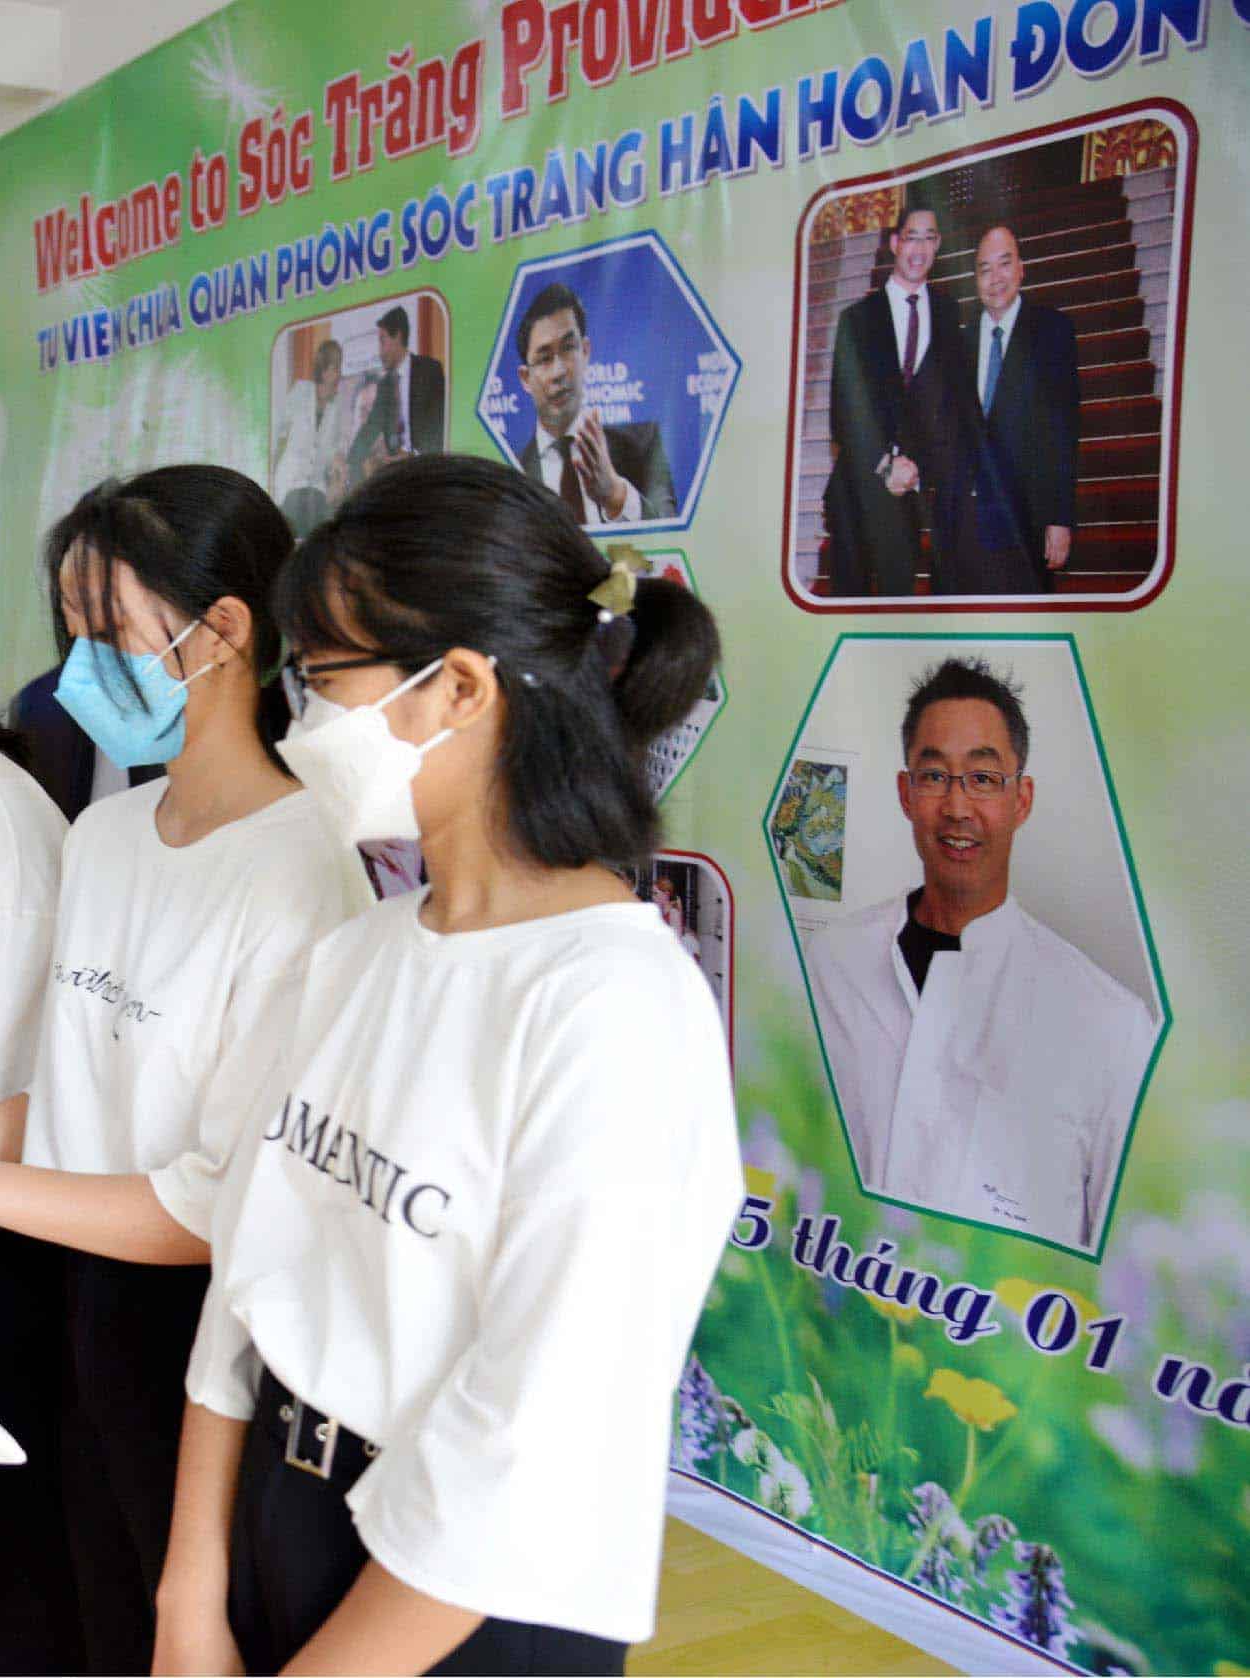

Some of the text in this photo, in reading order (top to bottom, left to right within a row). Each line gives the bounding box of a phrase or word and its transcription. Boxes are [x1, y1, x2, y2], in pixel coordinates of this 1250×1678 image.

[33, 174, 182, 295] Welcome
[189, 149, 230, 232] to
[237, 105, 313, 216] Sóc
[325, 41, 485, 181] Trăng
[188, 250, 270, 328] QUAN
[798, 16, 994, 160] HOAN
[732, 1197, 772, 1247] 5
[793, 1218, 1000, 1341] tháng
[1025, 1292, 1125, 1370] 01
